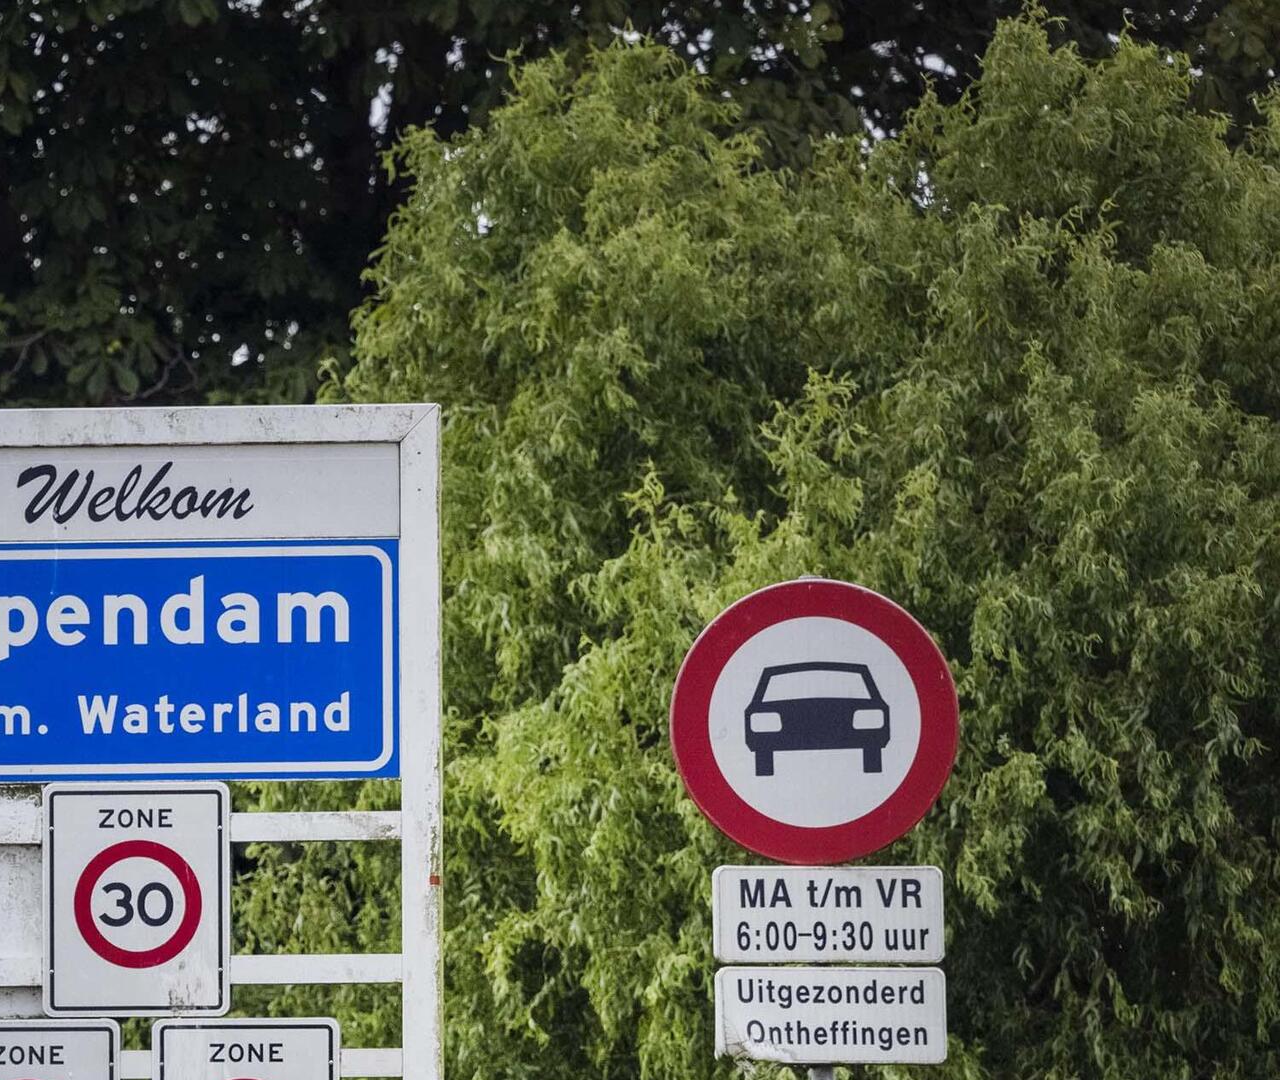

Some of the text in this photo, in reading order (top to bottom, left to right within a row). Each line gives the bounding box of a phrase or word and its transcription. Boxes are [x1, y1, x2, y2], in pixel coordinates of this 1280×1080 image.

[17, 462, 253, 524] Welkom
[78, 692, 349, 734] Waterland
[99, 809, 172, 828] ZONE
[99, 882, 173, 927] 30
[740, 879, 921, 908] MA t/m VR
[885, 929, 929, 950] uur
[738, 979, 924, 1008] Uitgezonderd
[747, 1020, 927, 1051] Ontheffingen
[210, 1043, 283, 1062] ZONE
